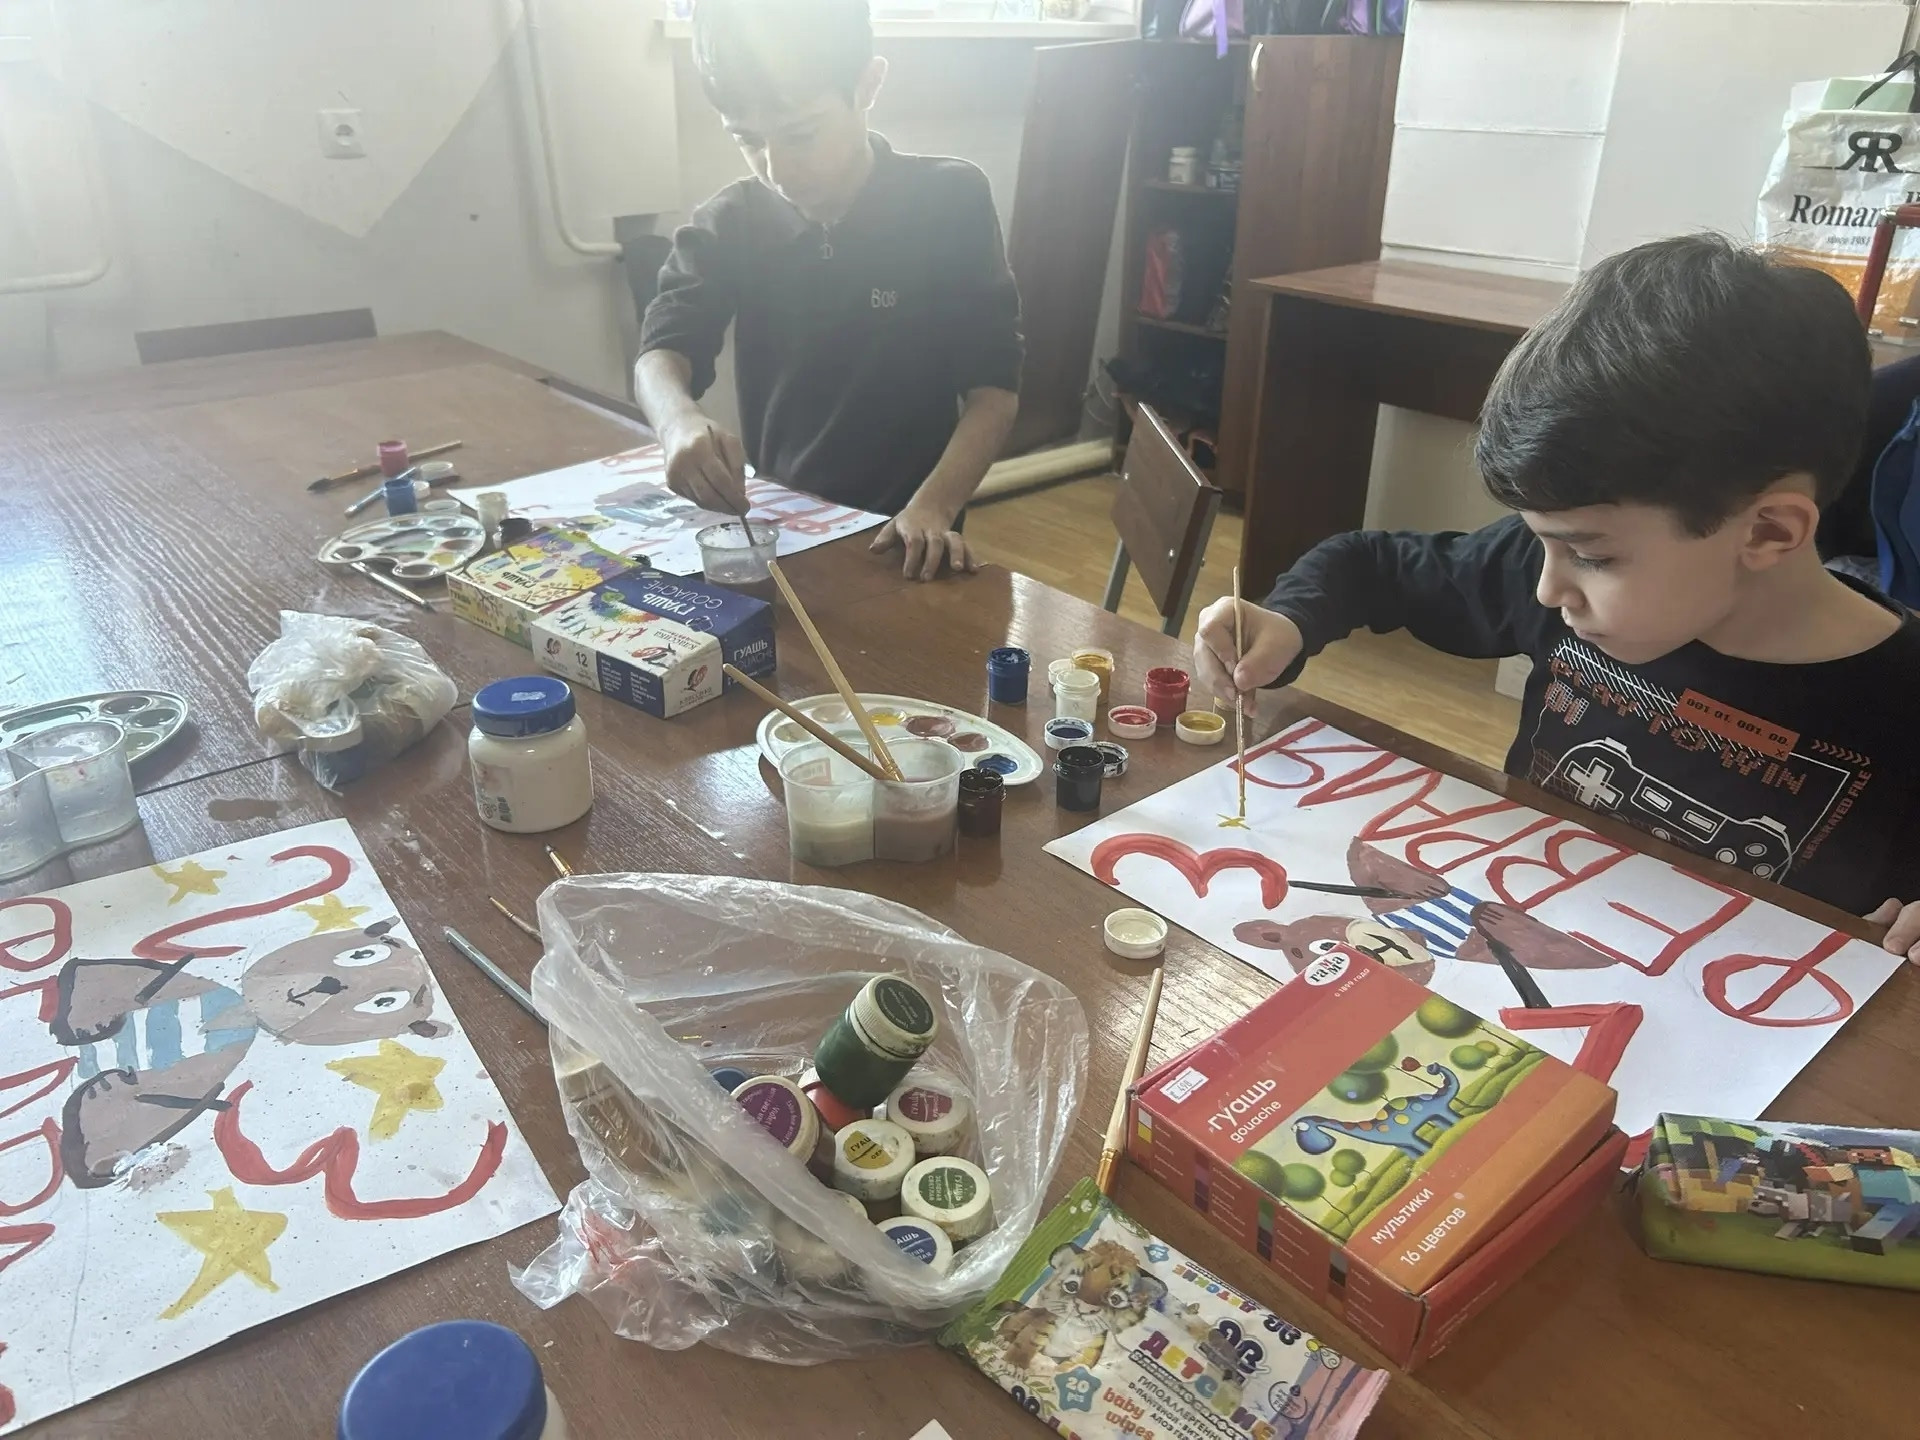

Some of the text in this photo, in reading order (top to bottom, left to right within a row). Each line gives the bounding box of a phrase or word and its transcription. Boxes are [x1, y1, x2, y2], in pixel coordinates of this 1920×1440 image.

[500, 572, 536, 588] ГУАШЬ
[643, 580, 722, 609] GOUACHE
[642, 593, 696, 615] ГУАШЬ
[575, 651, 589, 668] 12
[733, 640, 768, 661] ГУАШЬ
[1844, 770, 1872, 801] FILE
[1354, 968, 1370, 983] года
[1208, 1079, 1277, 1131] гуашь
[1229, 1100, 1282, 1144] gouache
[1371, 1188, 1434, 1245] мультики
[1400, 1207, 1466, 1266] 16 цветов
[1172, 1264, 1256, 1314] ДЕТСКИЕ
[1066, 1377, 1090, 1394] 20
[1139, 1330, 1276, 1440] ДЕТСКИЕ
[1103, 1387, 1145, 1420] baby
[1105, 1411, 1155, 1440] wipes
